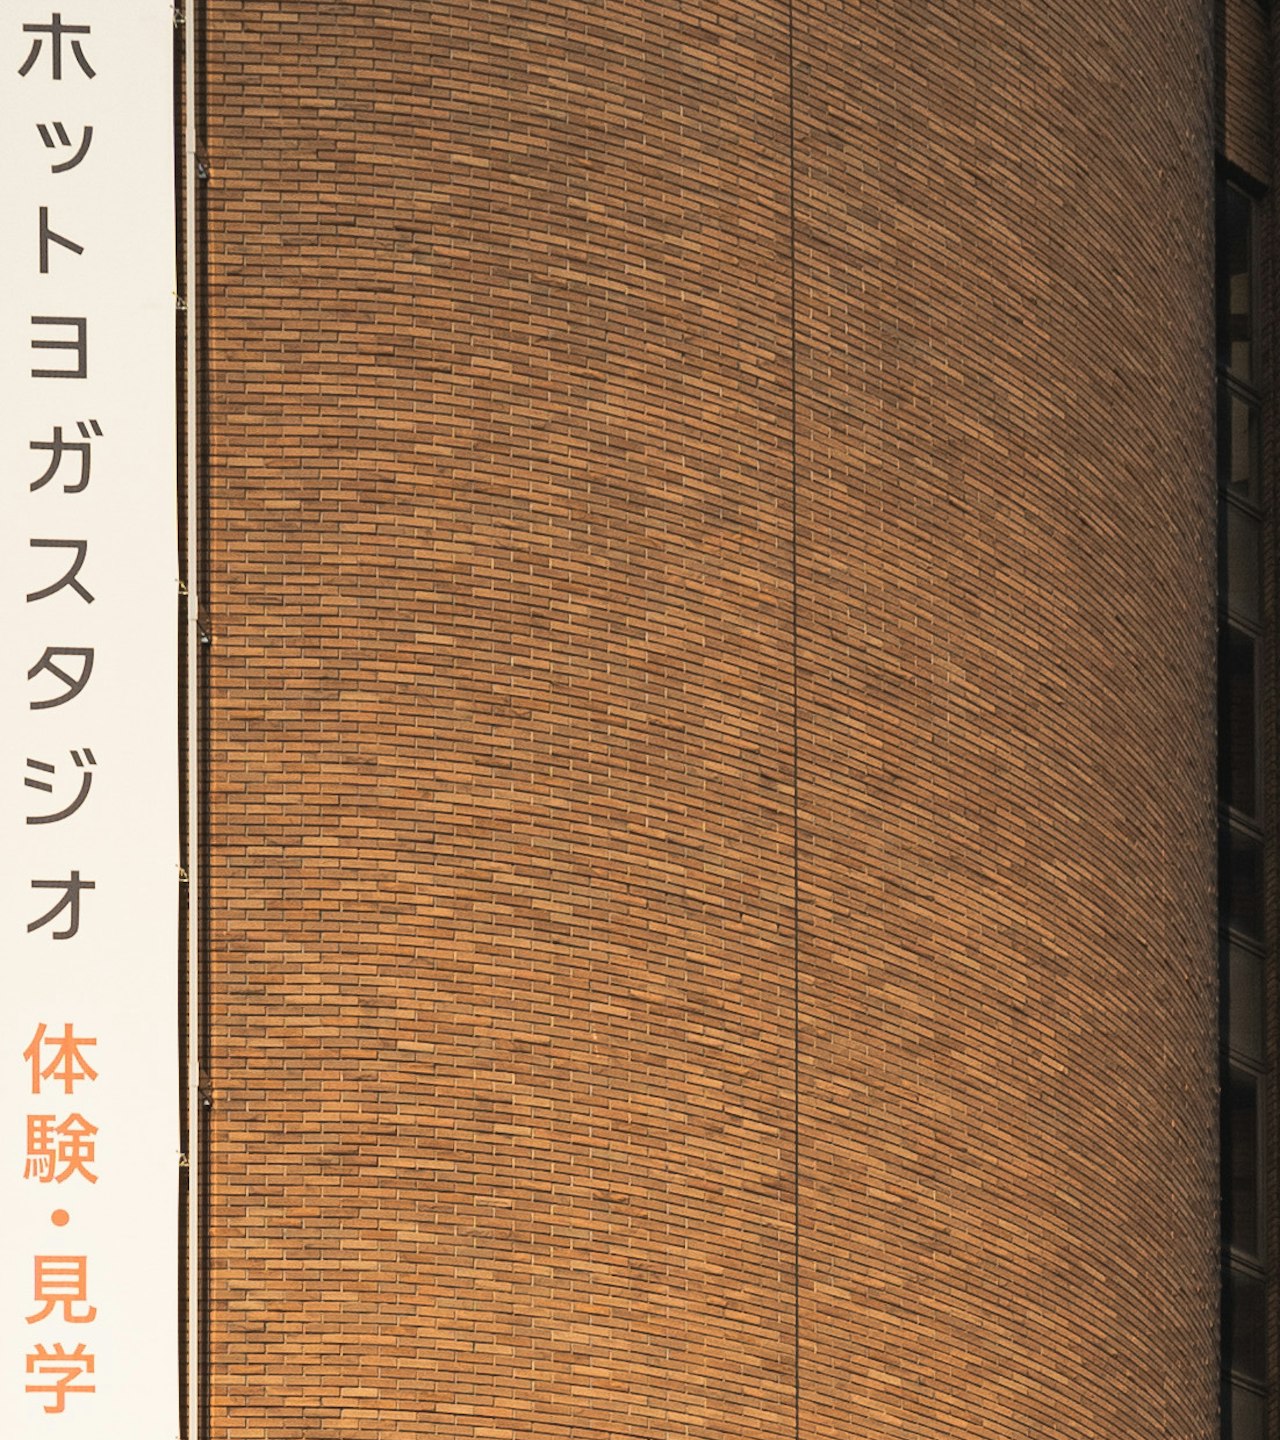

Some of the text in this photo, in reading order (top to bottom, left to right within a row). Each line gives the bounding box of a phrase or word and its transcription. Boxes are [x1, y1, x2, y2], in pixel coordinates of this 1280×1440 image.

[17, 11, 103, 941] ホットヨガスタジオ
[22, 1022, 99, 1415] 体験・見学
